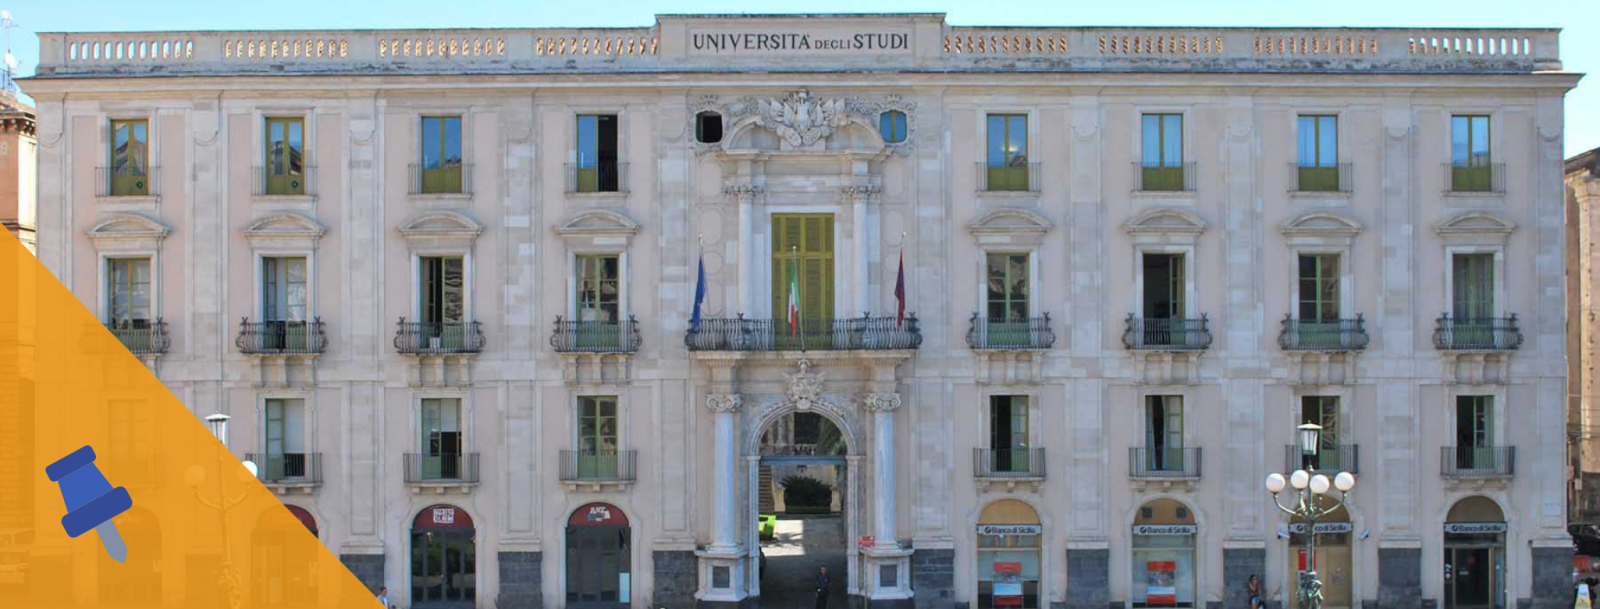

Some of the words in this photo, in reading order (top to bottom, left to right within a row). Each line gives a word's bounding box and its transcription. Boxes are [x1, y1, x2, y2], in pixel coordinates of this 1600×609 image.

[814, 39, 851, 50] DEGLI
[853, 33, 909, 50] STUDI
[992, 526, 1011, 534] Banco
[1018, 526, 1036, 534] Sicilia
[1147, 526, 1166, 534] Banco
[1173, 526, 1191, 534] Sicilia
